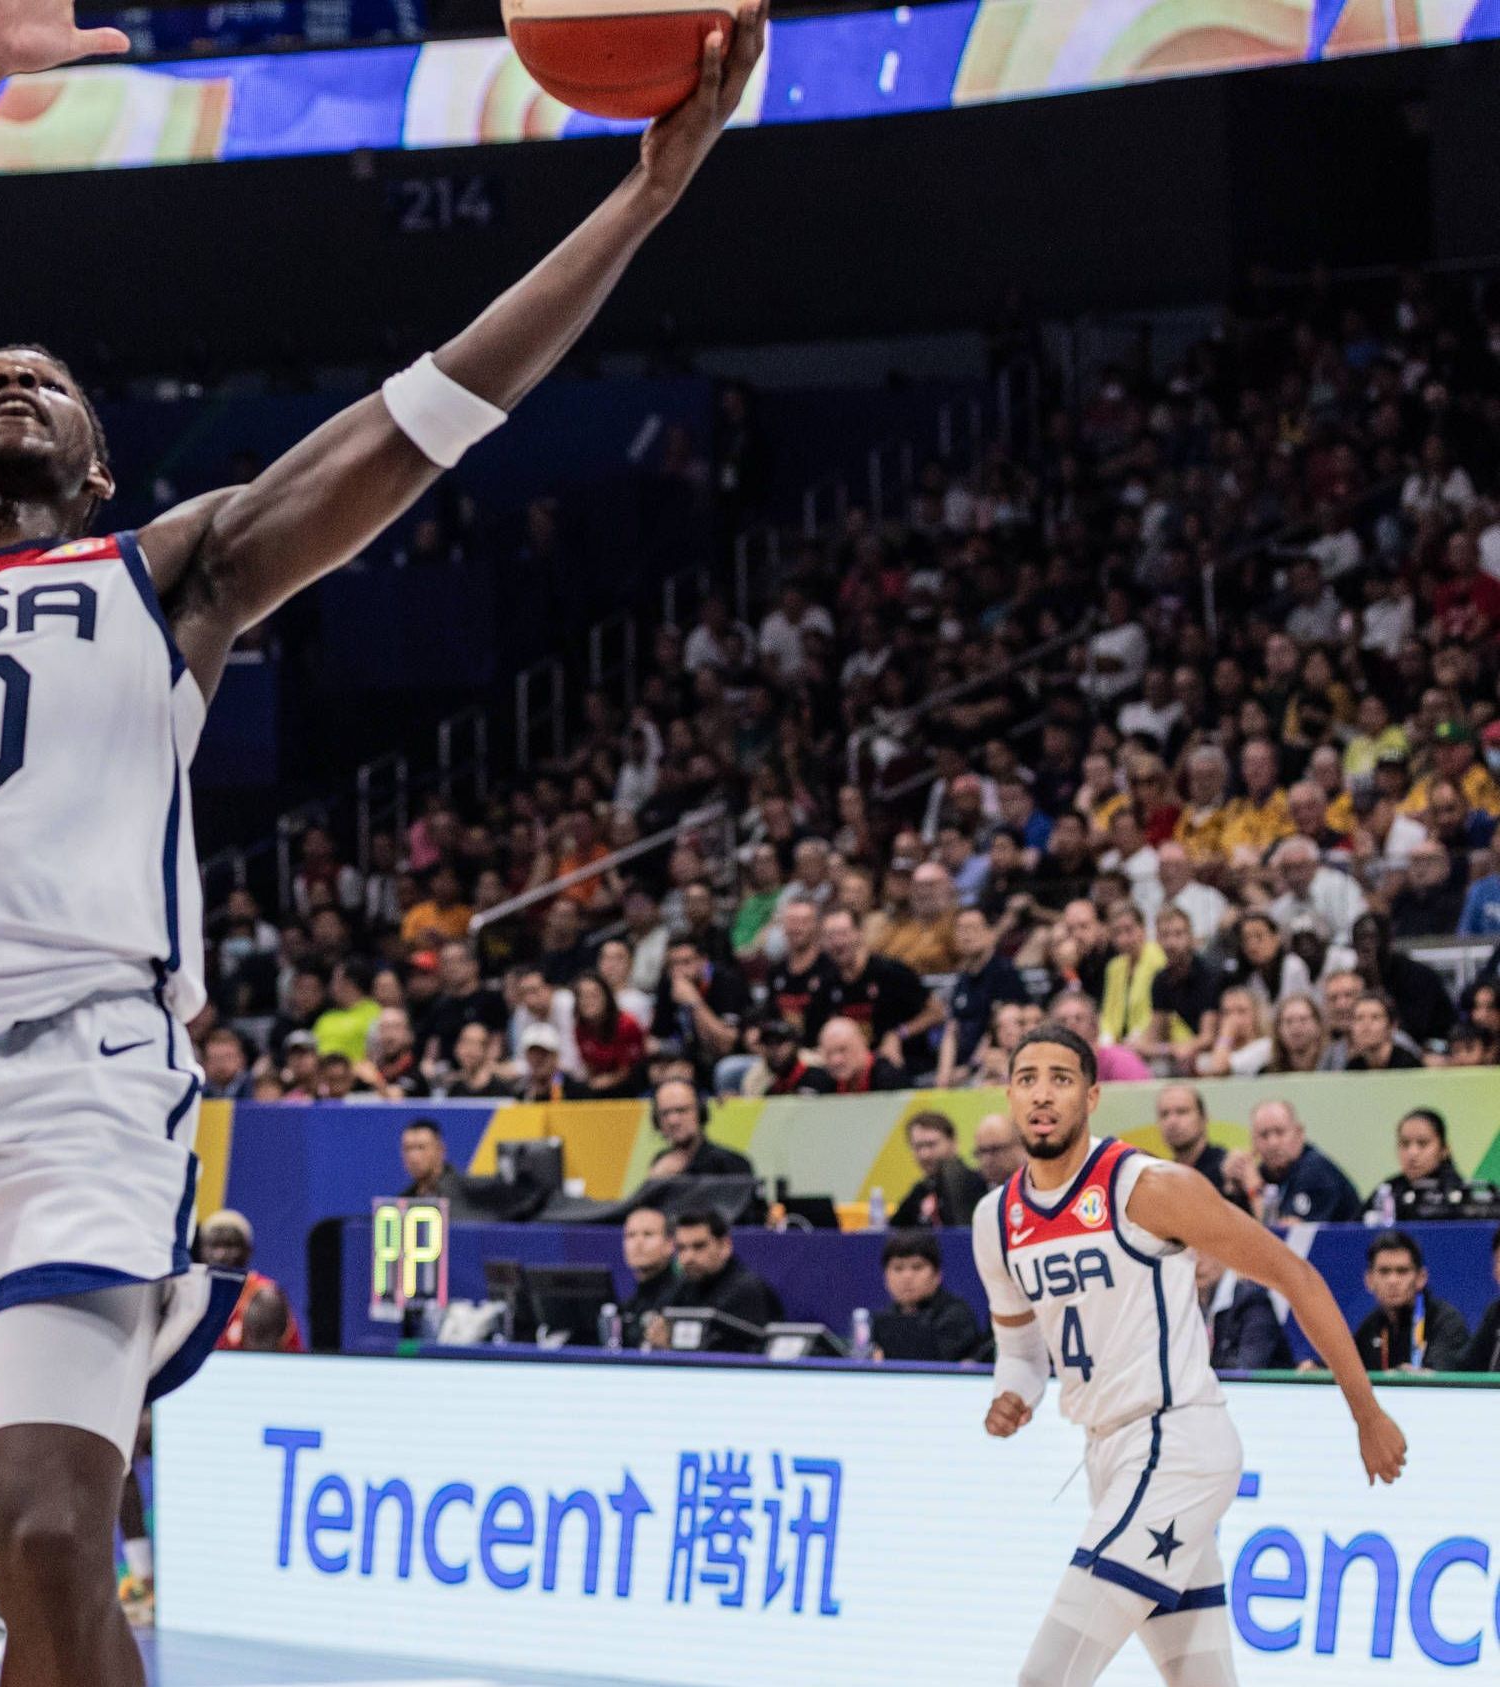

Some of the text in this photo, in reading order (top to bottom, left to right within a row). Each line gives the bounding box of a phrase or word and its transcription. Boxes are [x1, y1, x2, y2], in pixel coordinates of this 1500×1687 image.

[401, 174, 491, 229] 214
[1014, 1247, 1115, 1302] USA
[1060, 1304, 1095, 1384] 4
[262, 1427, 843, 1617] Tencent 腾讯
[1231, 1472, 1500, 1667] enc
